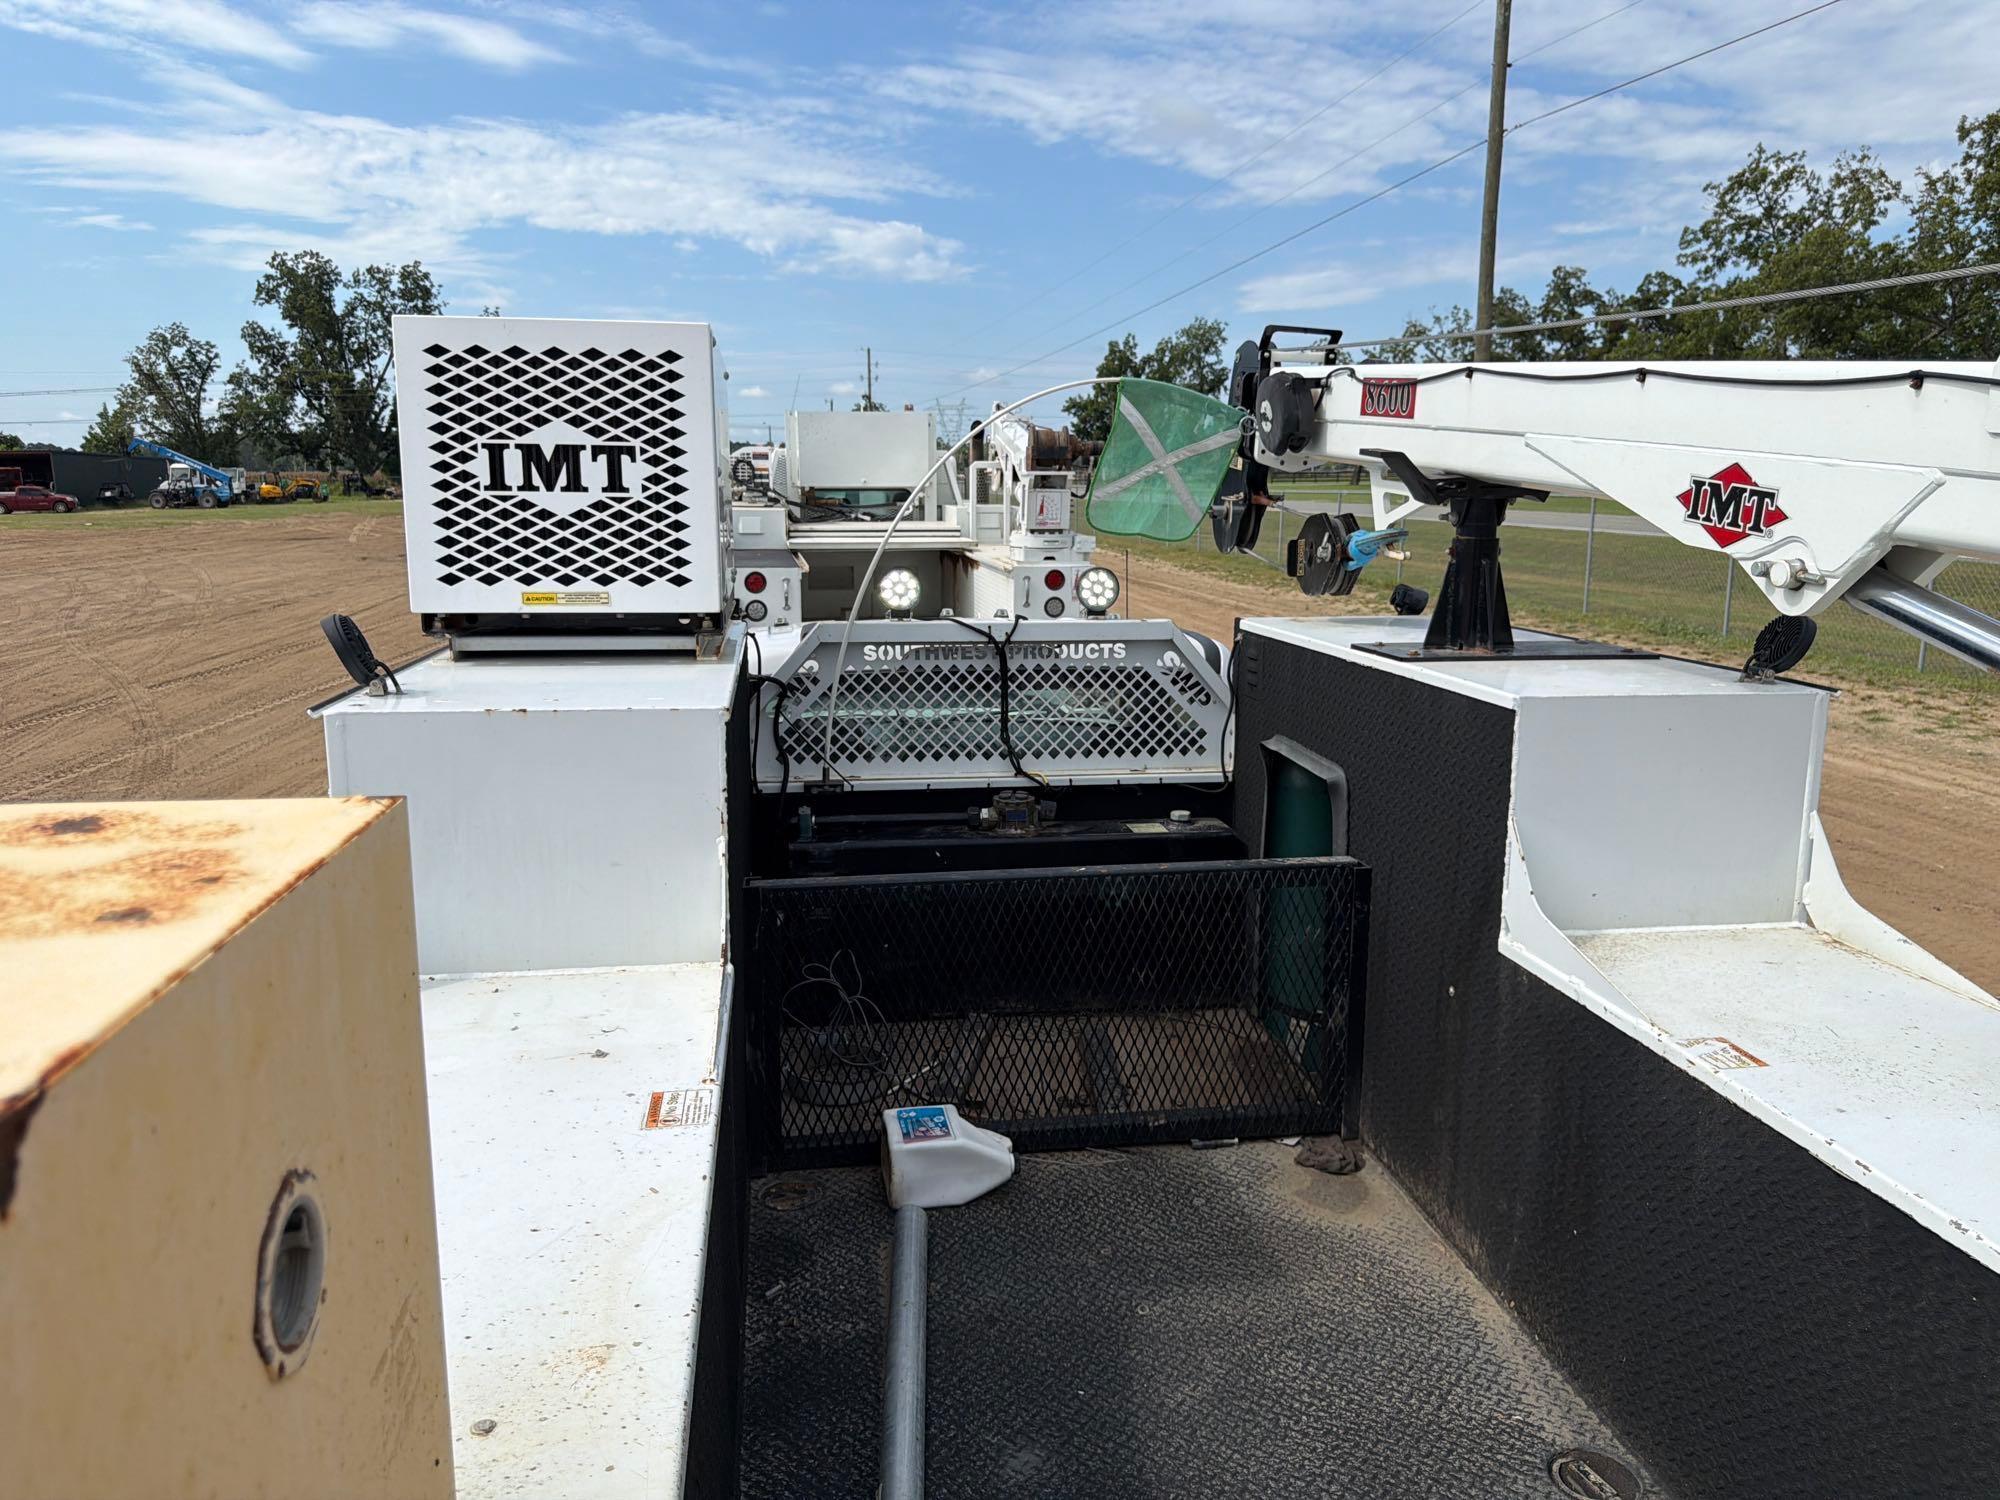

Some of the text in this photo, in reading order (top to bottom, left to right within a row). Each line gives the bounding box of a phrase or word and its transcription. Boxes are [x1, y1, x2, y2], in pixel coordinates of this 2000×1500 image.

[1365, 380, 1412, 416] 8600
[481, 443, 637, 493] IMT
[1685, 477, 1778, 536] IMT
[863, 643, 1126, 661] SOUTHWEST PRODUCTS
